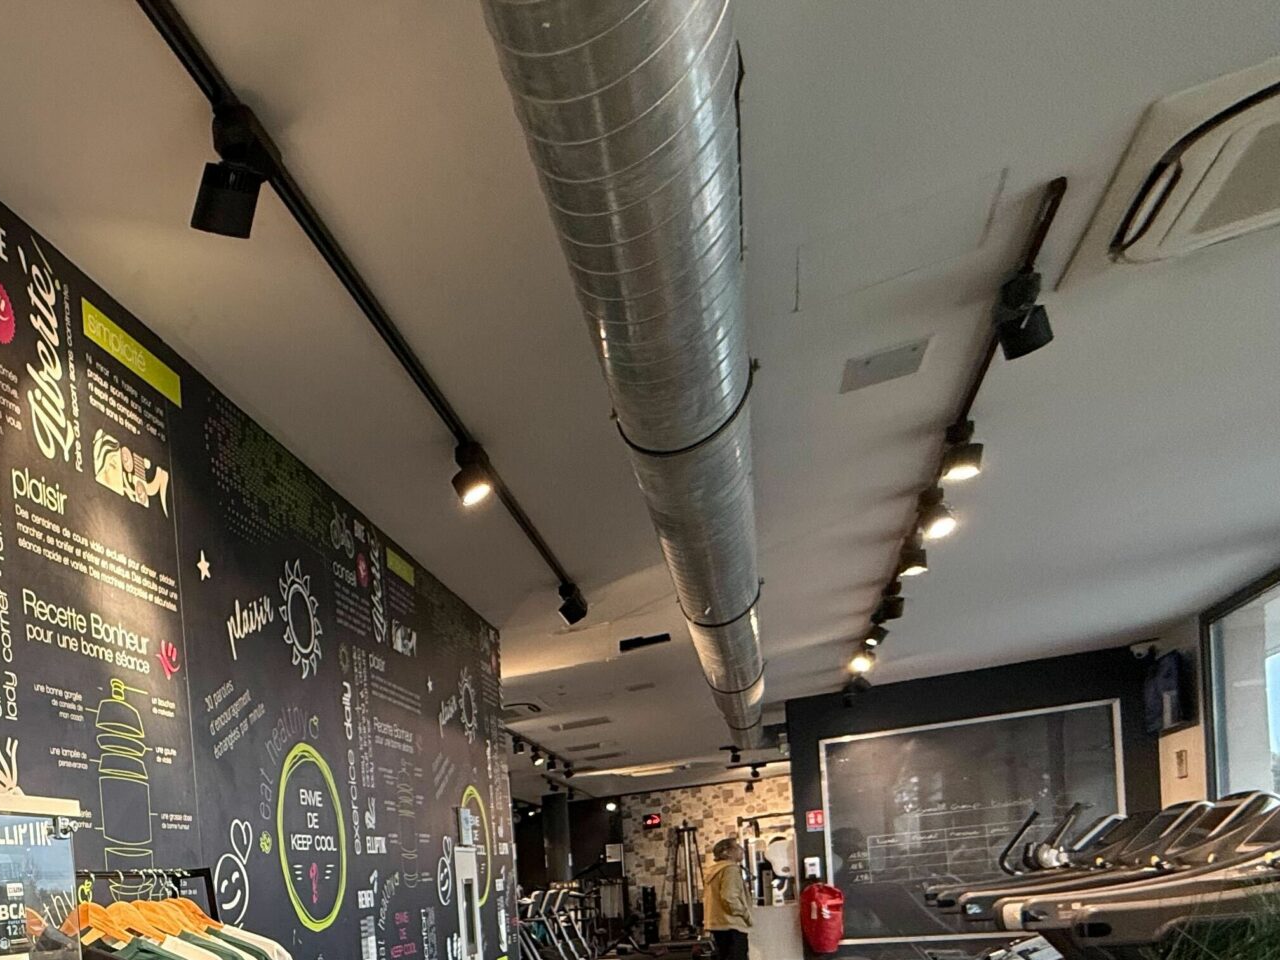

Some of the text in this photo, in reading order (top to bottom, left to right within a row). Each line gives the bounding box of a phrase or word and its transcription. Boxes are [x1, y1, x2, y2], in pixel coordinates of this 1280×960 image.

[86, 312, 147, 373] simplicité
[12, 467, 67, 515] plaisir
[15, 503, 89, 548] Des centaines de cours
[18, 537, 62, 565] séance rapide
[22, 588, 150, 656] Recette Bonheur
[227, 595, 274, 660] plaisir
[26, 622, 150, 674] pour une bonne séance
[2, 672, 18, 721] lady
[34, 683, 63, 697] une bonne
[215, 679, 236, 710] paroles
[259, 705, 310, 821] eat healthy
[299, 788, 323, 808] ENVIE
[307, 812, 320, 829] DE
[348, 749, 362, 856] exercice
[290, 834, 337, 852] KEEP COOL
